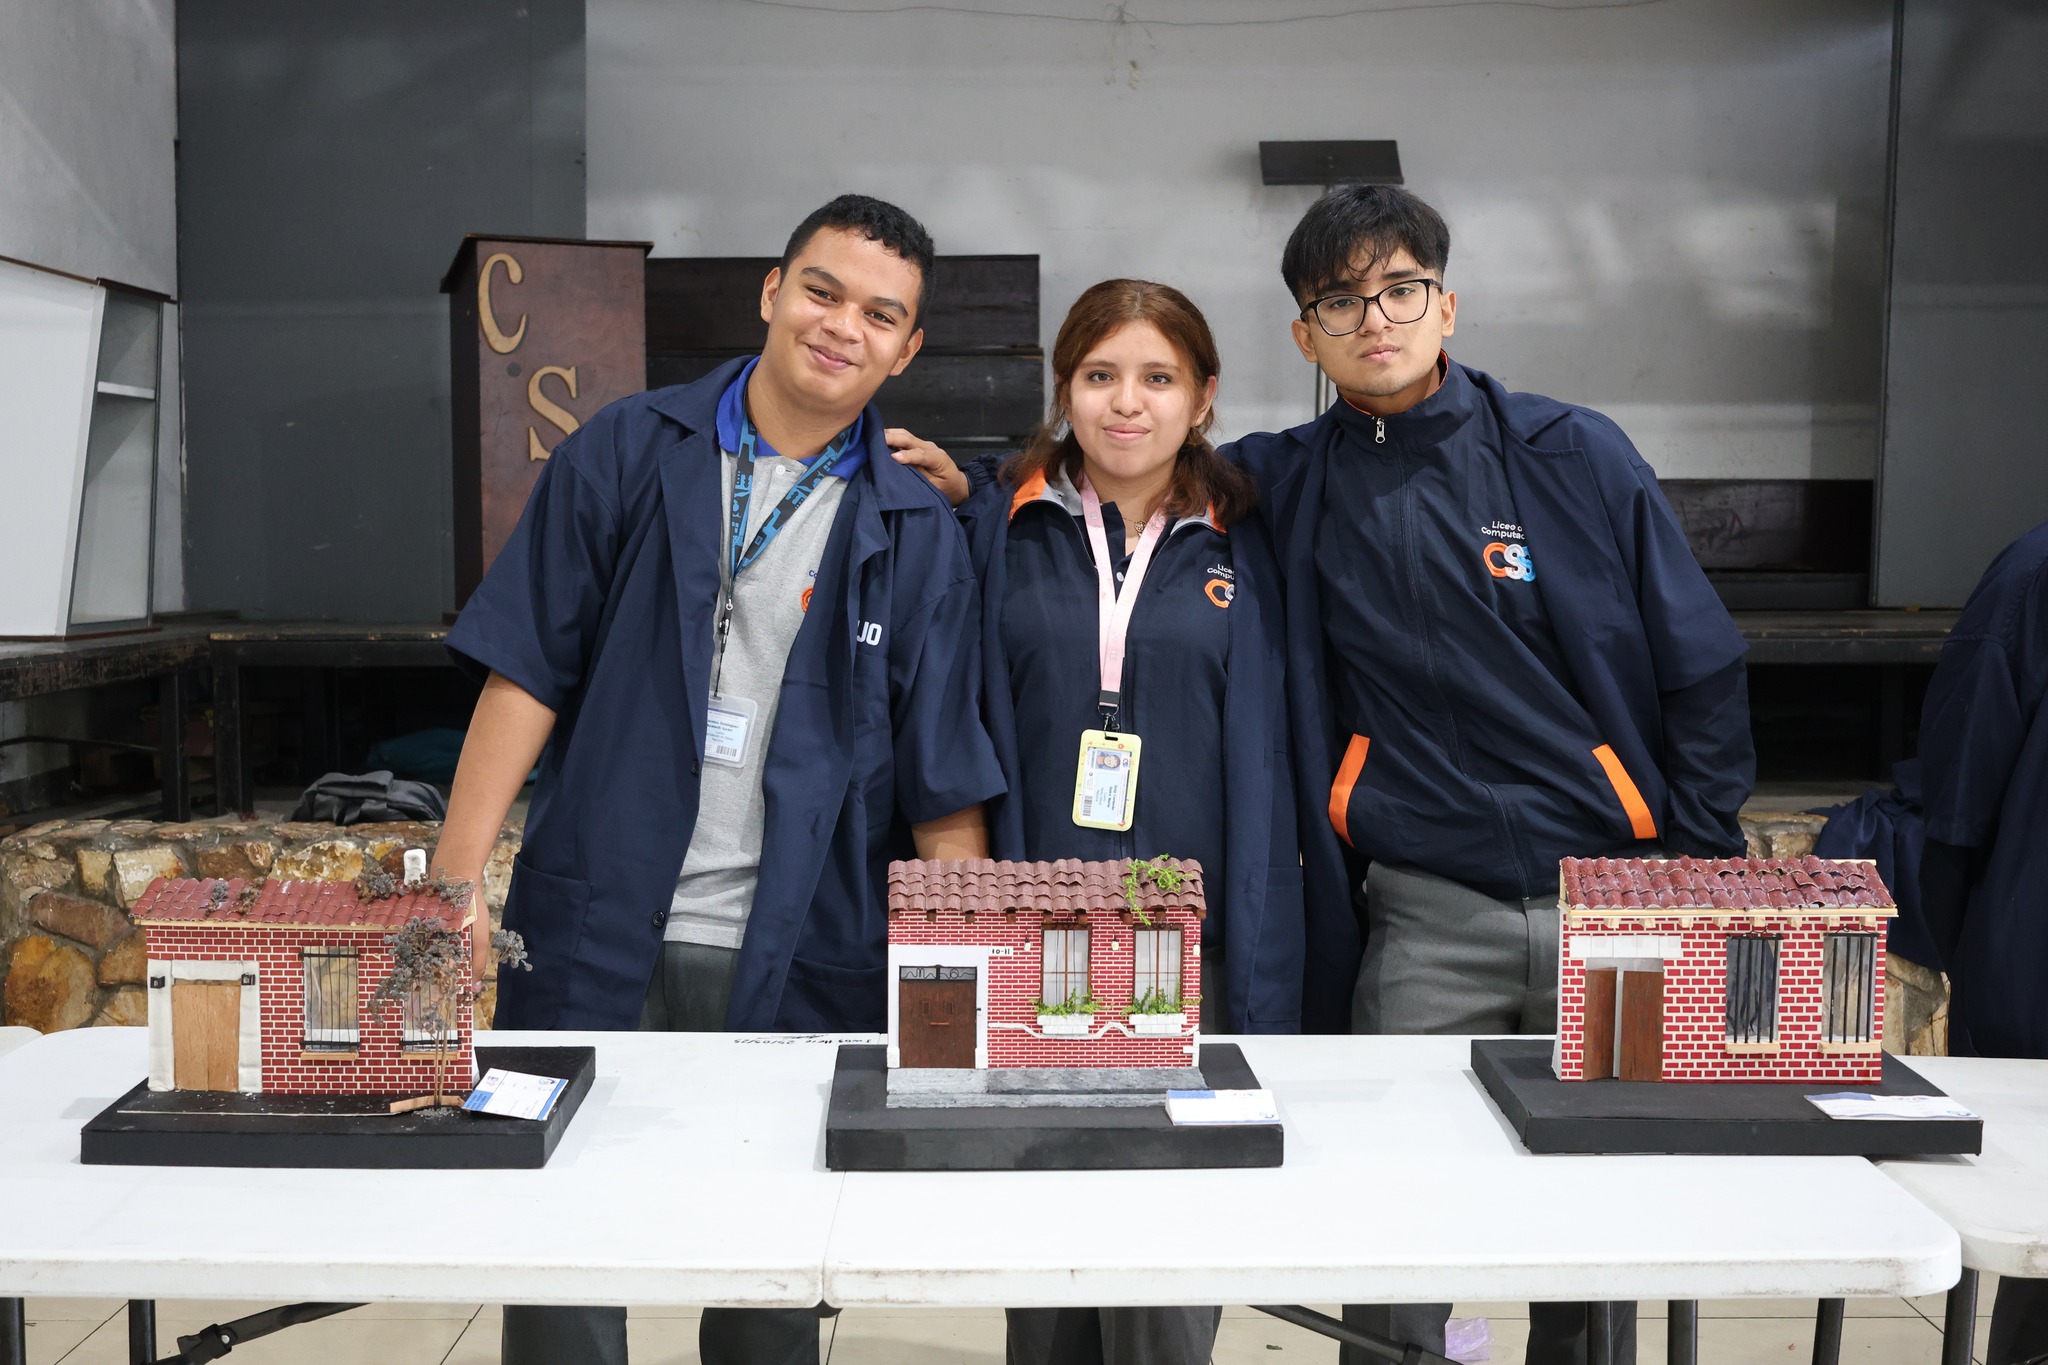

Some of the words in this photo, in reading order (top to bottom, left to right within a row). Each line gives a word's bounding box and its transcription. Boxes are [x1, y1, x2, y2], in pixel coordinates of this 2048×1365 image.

[478, 253, 528, 354] C
[527, 364, 580, 461] S
[1481, 526, 1525, 540] Computac
[1491, 521, 1516, 531] Liceo
[1206, 567, 1235, 580] Compu
